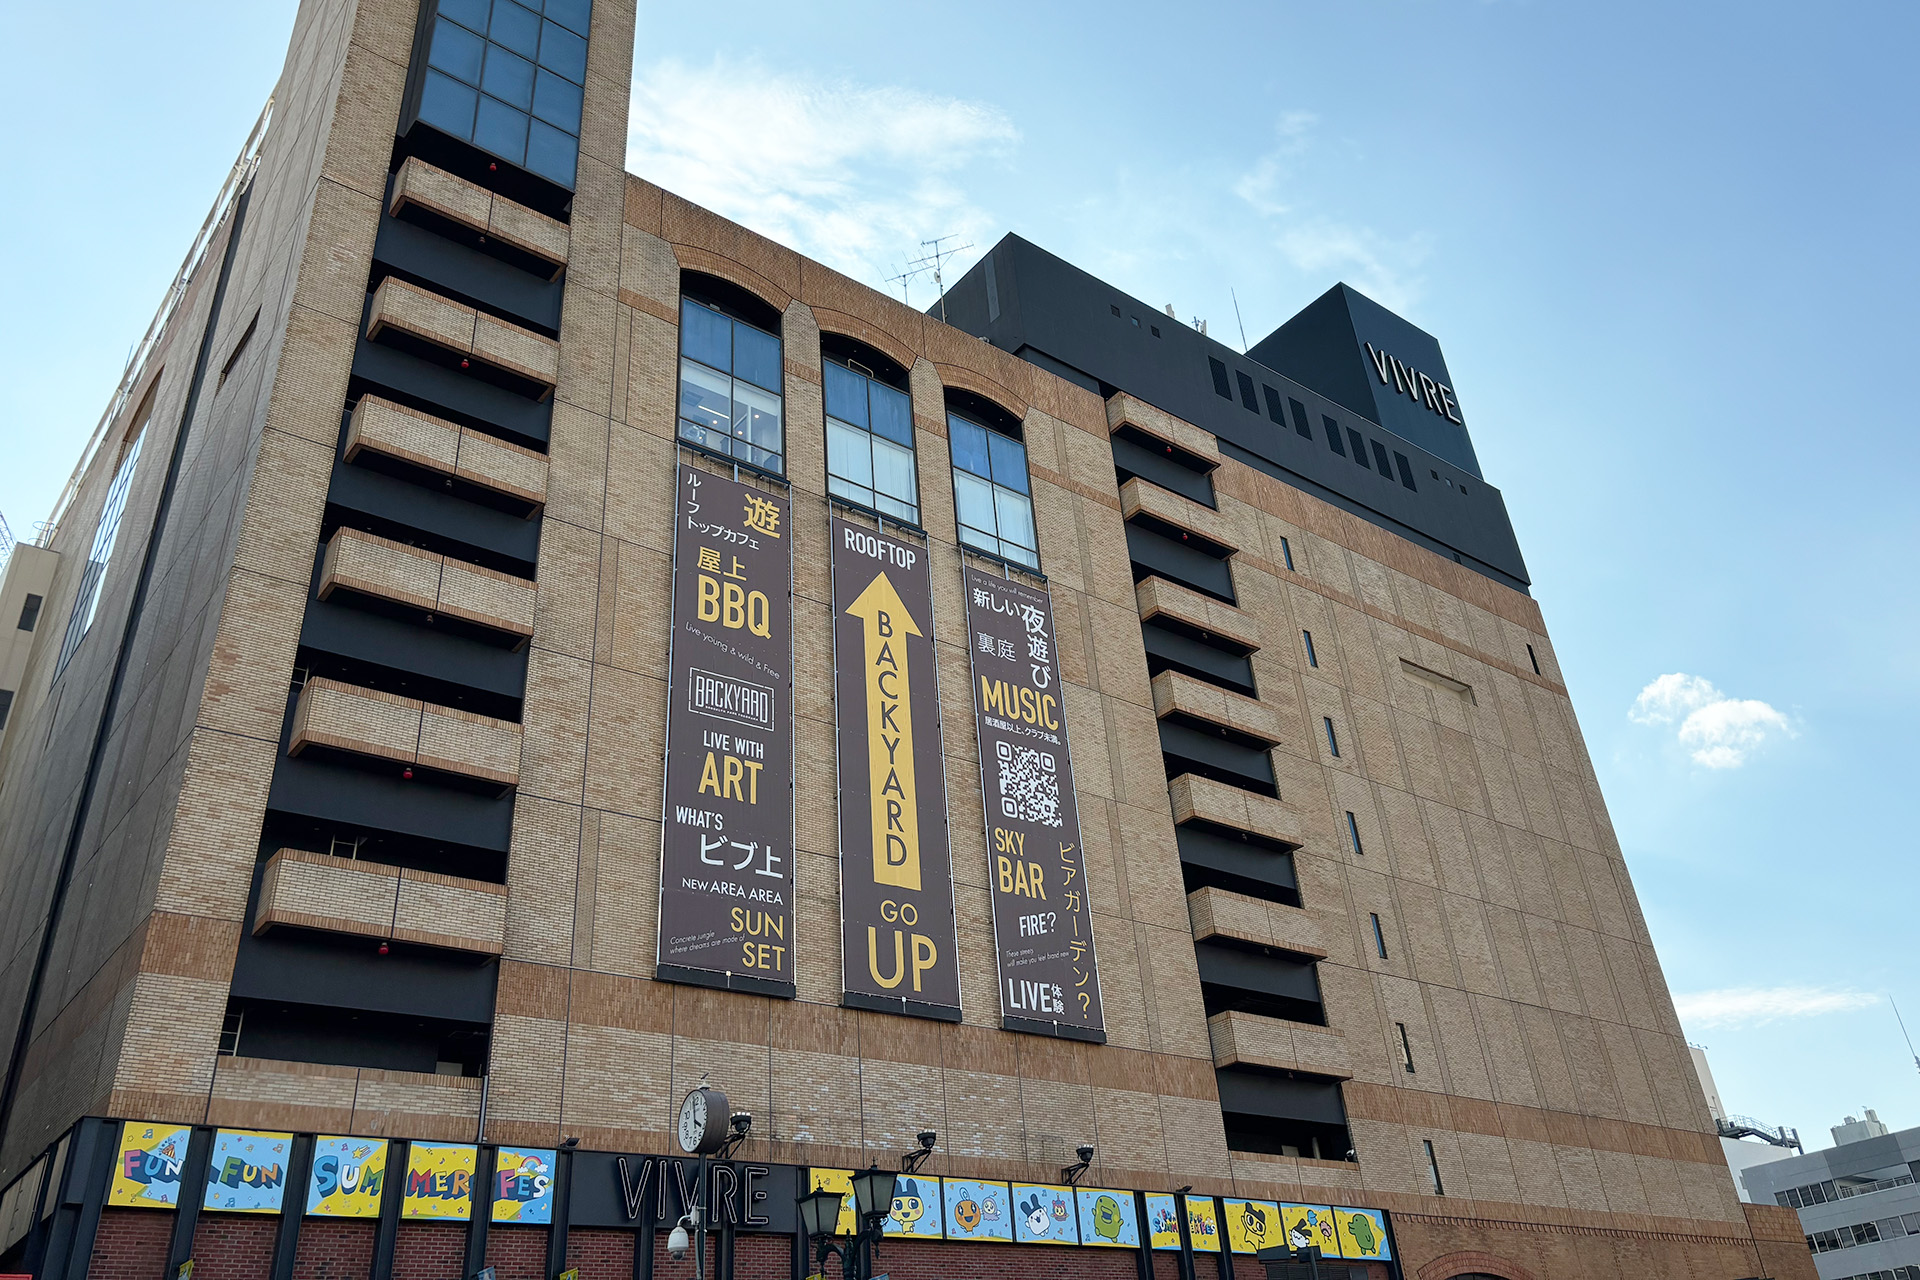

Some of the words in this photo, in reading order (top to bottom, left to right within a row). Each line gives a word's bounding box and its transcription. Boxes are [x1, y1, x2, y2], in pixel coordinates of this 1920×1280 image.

[1364, 341, 1462, 425] VIVRE
[743, 493, 781, 539] 遊
[697, 546, 747, 581] 屋上
[844, 527, 916, 571] ROOFTOP
[971, 574, 982, 584] Live
[697, 574, 772, 639] BBQ
[973, 587, 1020, 617] 新しい
[685, 621, 702, 636] Live
[702, 632, 728, 653] young
[737, 651, 755, 665] wild
[763, 663, 780, 680] Free
[977, 631, 1017, 663] 裏庭
[1019, 603, 1051, 689] 夜遊び
[695, 675, 768, 724] BACKYARD
[981, 675, 1059, 731] MUSIC
[703, 730, 730, 751] LIVE
[734, 737, 764, 760] WITH
[875, 609, 907, 868] BACKYARD
[698, 751, 763, 805] ART
[676, 805, 723, 831] WHAT'S
[700, 833, 783, 879] ビブ上
[994, 827, 1025, 857] SKY
[682, 878, 708, 892] NEW
[709, 880, 746, 900] AREA
[748, 888, 784, 906] AREA
[997, 855, 1047, 901] BAR
[730, 907, 784, 941] SUN
[880, 899, 918, 926] GO
[1018, 912, 1057, 938] FIRE?
[670, 934, 697, 945] Concrete
[742, 941, 786, 972] SET
[867, 925, 938, 992] UP
[1008, 978, 1052, 1013] LIVE
[124, 1149, 184, 1184] FUN
[220, 1157, 282, 1188] FUN
[314, 1154, 384, 1198] SUM
[406, 1167, 471, 1201] MER
[495, 1168, 551, 1201] FES
[618, 1157, 769, 1225] VIVRE
